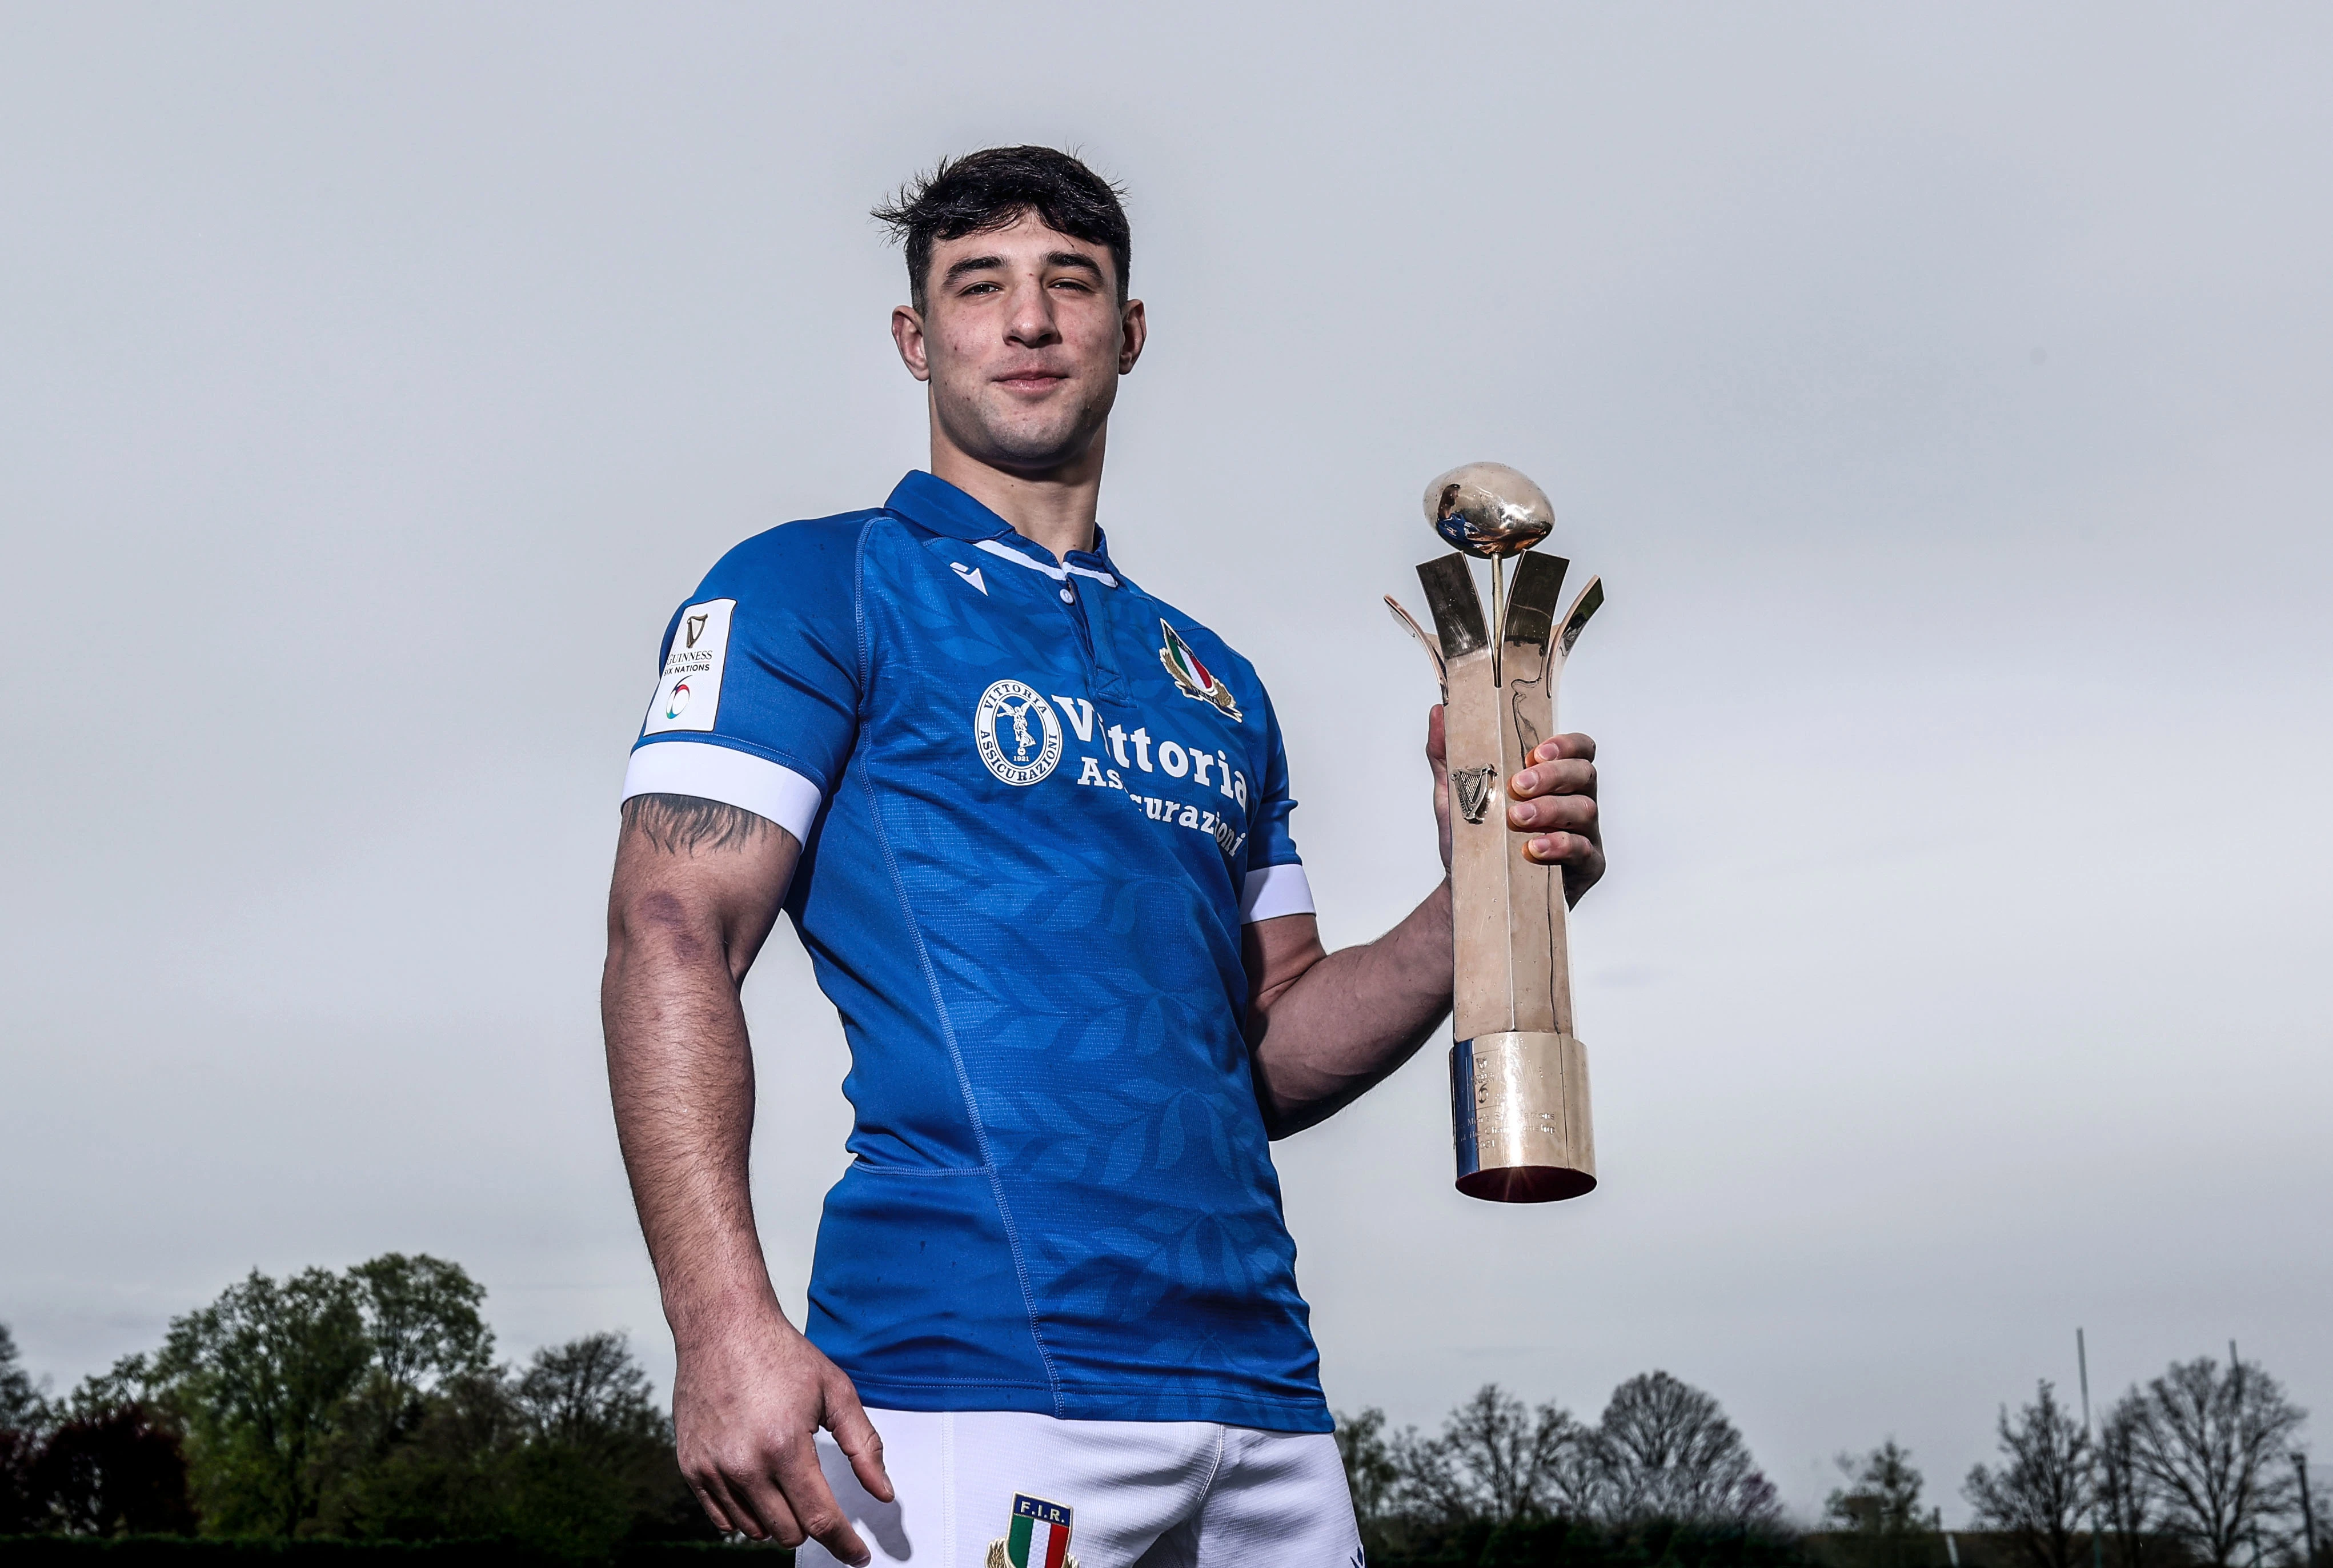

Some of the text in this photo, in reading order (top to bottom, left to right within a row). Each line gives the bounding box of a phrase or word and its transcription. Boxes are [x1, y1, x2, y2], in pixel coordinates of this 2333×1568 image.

[664, 664, 709, 676] SIX NATIONS
[667, 651, 712, 665] GUINNESS
[984, 684, 1047, 713] VITTORIA
[980, 730, 1057, 781] ASSICURAZIONI
[1077, 757, 1246, 857] Asurazioni
[1021, 1501, 1065, 1523] F.I.R.
